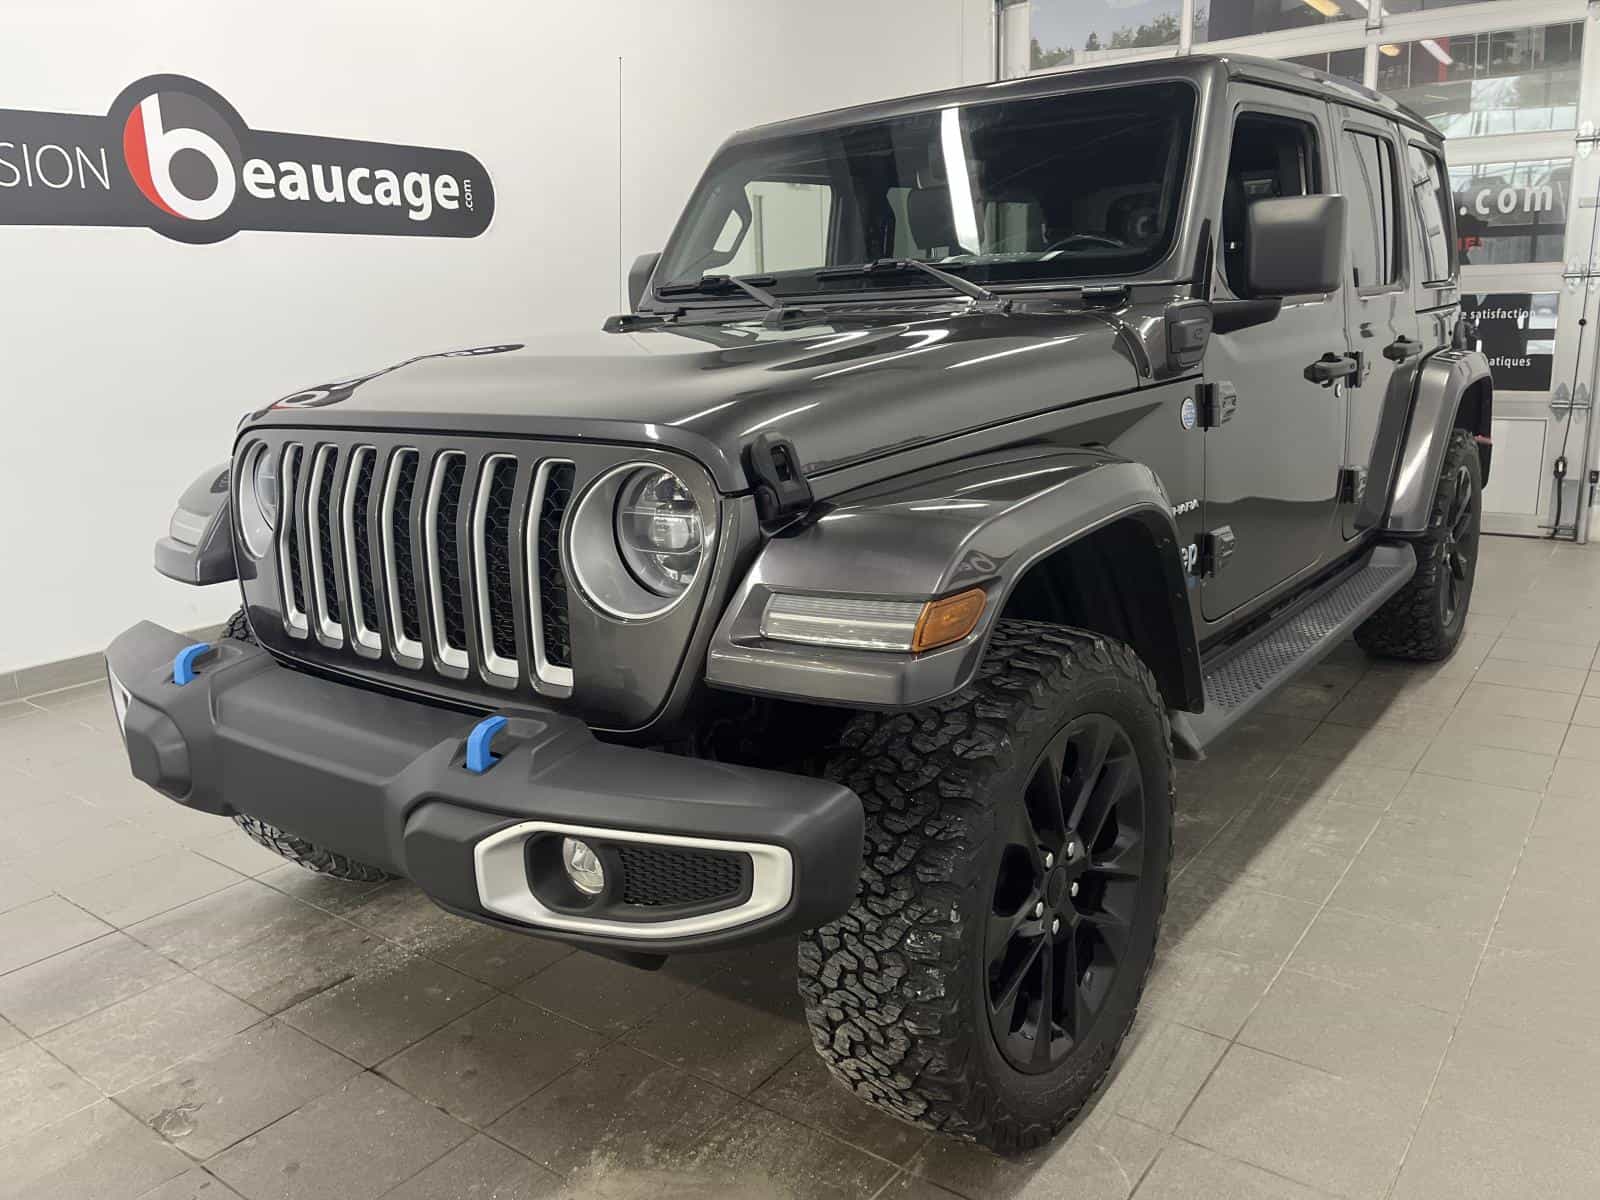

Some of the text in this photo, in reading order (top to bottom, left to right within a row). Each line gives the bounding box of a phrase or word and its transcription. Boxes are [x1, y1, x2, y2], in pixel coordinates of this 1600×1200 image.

[0, 142, 110, 190] SION
[463, 179, 475, 212] .com
[1459, 184, 1553, 216] .com
[1470, 307, 1536, 320] satisfaction
[1488, 355, 1532, 369] atiques
